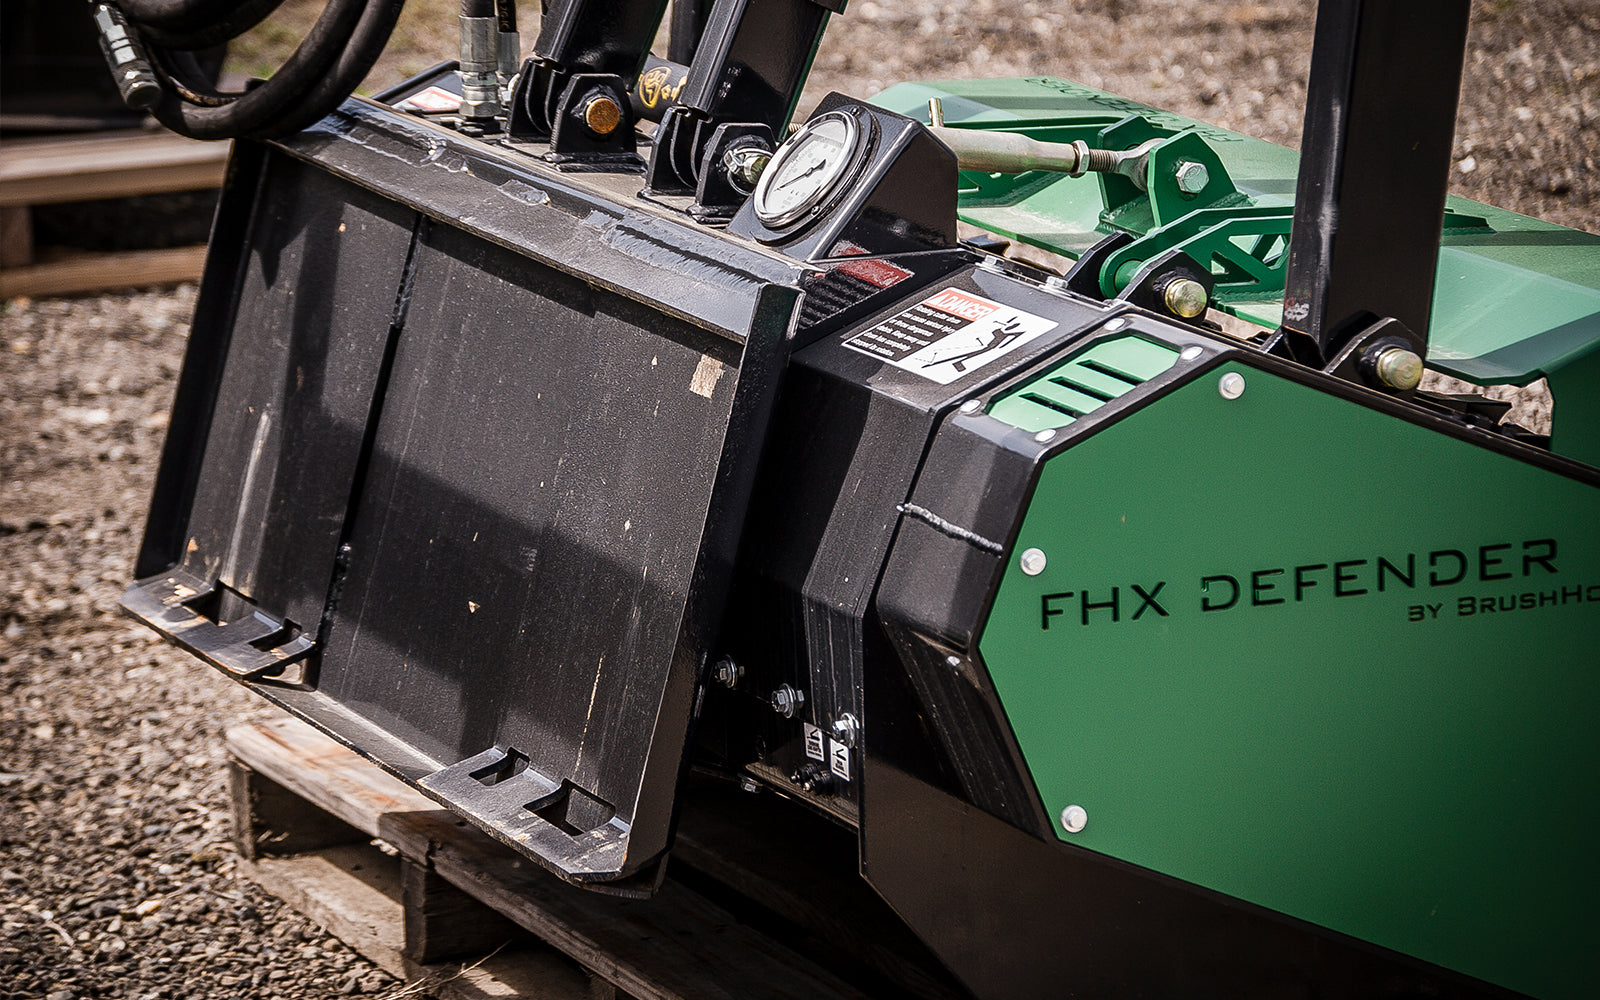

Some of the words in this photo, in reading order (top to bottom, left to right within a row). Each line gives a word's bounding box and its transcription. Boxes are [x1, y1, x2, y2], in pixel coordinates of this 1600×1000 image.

[937, 295, 995, 321] DANGER
[1041, 580, 1170, 631] FHX
[1200, 538, 1559, 612] DEFENDER
[1407, 602, 1445, 623] BY
